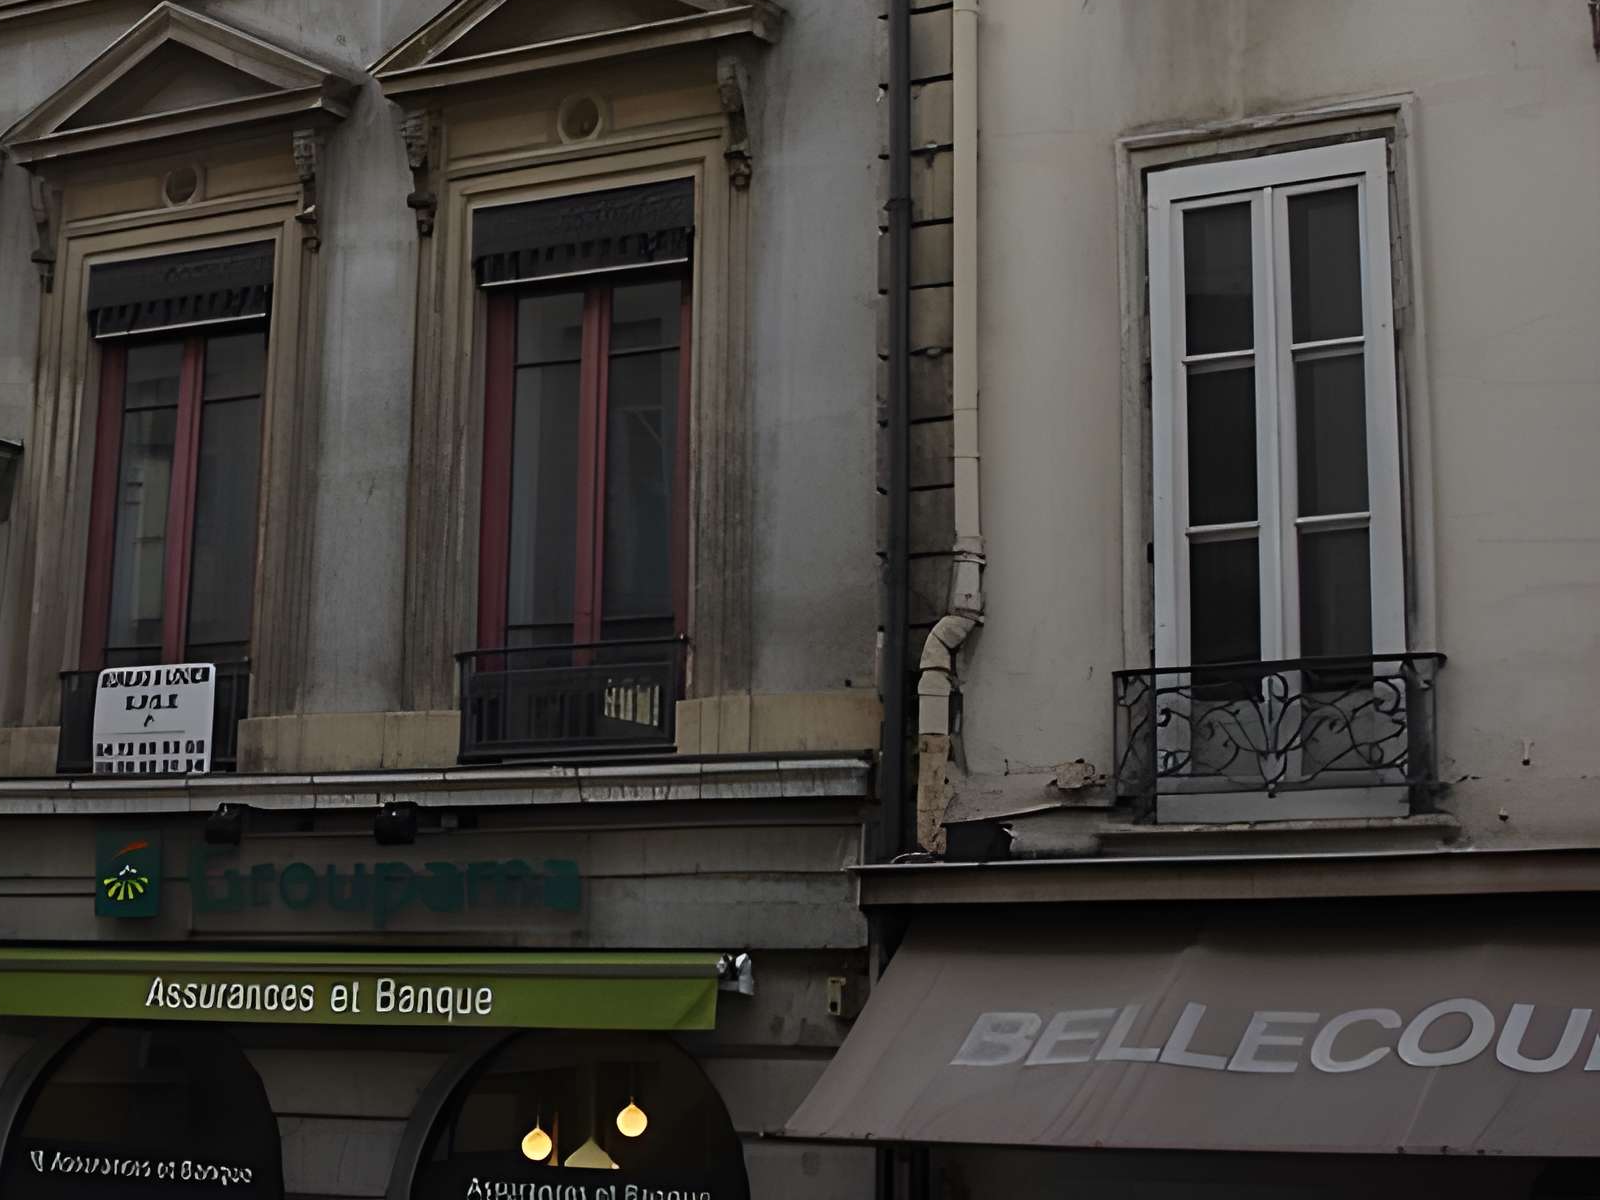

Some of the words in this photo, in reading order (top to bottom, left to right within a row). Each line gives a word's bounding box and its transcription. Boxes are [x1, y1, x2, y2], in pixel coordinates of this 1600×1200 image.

[145, 976, 314, 1012] Assurances
[330, 981, 360, 1013] et
[376, 978, 493, 1022] Banque
[950, 997, 1600, 1074] BELLECOU
